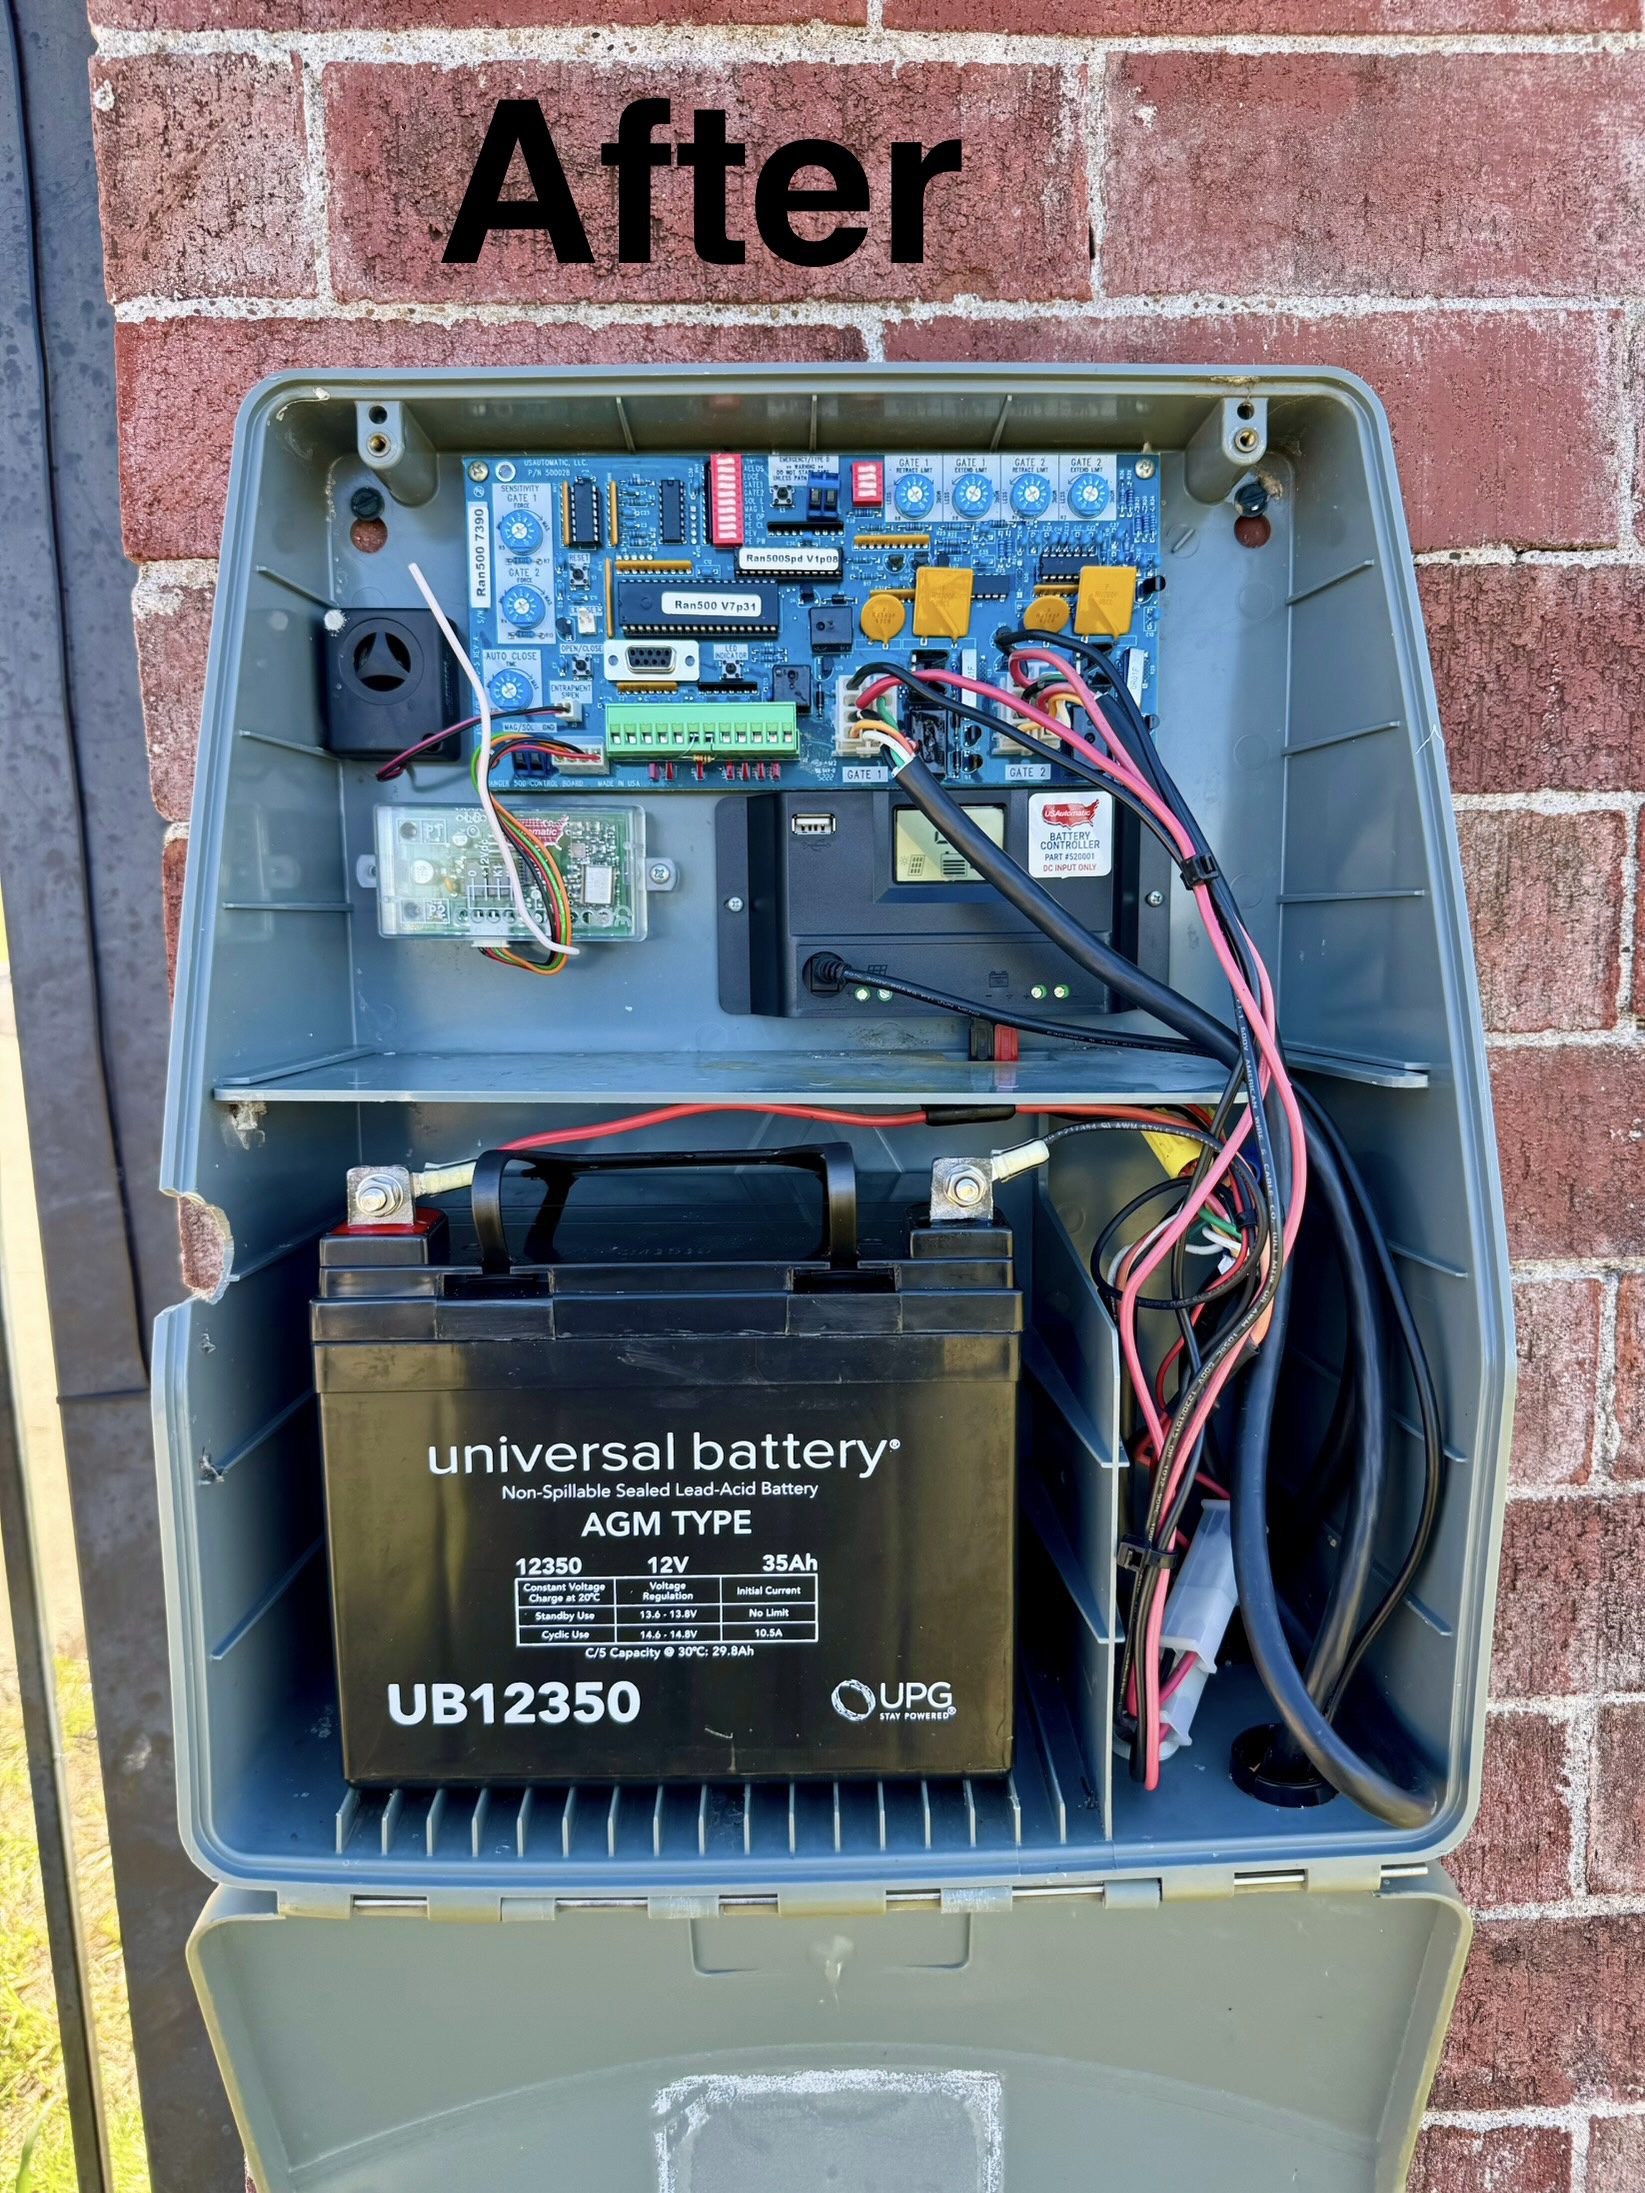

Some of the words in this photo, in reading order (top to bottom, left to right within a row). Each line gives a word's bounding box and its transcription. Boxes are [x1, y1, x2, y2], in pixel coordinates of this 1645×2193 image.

[899, 458, 920, 467] GATE
[956, 458, 977, 467] GATE
[1014, 458, 1036, 467] GATE
[1071, 458, 1092, 467] GATE
[507, 493, 530, 503] GATE
[473, 508, 485, 542] 7390
[569, 554, 590, 562] RESET
[746, 554, 803, 565] Ran500Spd
[806, 554, 839, 565] V1p08
[475, 546, 487, 597] Ran500
[508, 568, 530, 577] GATE
[675, 600, 718, 611] Ran500
[721, 600, 757, 613] V7p31
[561, 644, 602, 653] OPEN/CLOSE
[486, 652, 507, 661] AUTO
[511, 652, 537, 661] CLOSE
[551, 684, 593, 692] ENTRAPMENT
[847, 769, 872, 780] GATE
[1009, 768, 1034, 778] GATE
[1040, 768, 1046, 777] 2
[1049, 831, 1091, 841] BATTERY
[1040, 840, 1100, 851] CONTROLLER
[481, 839, 489, 878] +12Vdc
[1044, 853, 1063, 861] PART
[1043, 864, 1053, 872] DC
[1245, 1059, 1259, 1109] AMERICAN
[1263, 1163, 1274, 1196] CABLE
[1241, 1307, 1259, 1328] AWM
[428, 1432, 675, 1475] universal
[502, 1482, 612, 1502] Non-Spillable
[616, 1482, 670, 1498] Sealed
[676, 1480, 757, 1497] Lead-Acid
[760, 1480, 819, 1499] Battery
[581, 1510, 661, 1537] AGM
[671, 1509, 752, 1535] TYPE
[515, 1556, 583, 1576] 12350
[647, 1556, 690, 1575] 12V
[762, 1553, 818, 1572] 35Ah
[523, 1582, 566, 1592] Constant
[568, 1582, 606, 1593] Voltage
[649, 1581, 687, 1592] Voltage
[736, 1586, 763, 1595] Initial
[765, 1585, 801, 1595] Current
[529, 1594, 563, 1604] Charge
[565, 1594, 576, 1602] at
[642, 1591, 694, 1602] Regulation
[535, 1611, 575, 1622] Standby
[577, 1611, 595, 1620] Use
[640, 1610, 661, 1619] 13.6
[669, 1609, 698, 1618] 13.8V
[749, 1608, 764, 1617] No
[766, 1608, 789, 1617] Limit
[541, 1630, 569, 1641] Cyclic
[571, 1630, 590, 1639] Use
[640, 1630, 661, 1639] 14.6
[670, 1630, 698, 1639] 14.8V
[755, 1628, 783, 1637] 10.5A
[585, 1648, 606, 1658] C/5
[609, 1647, 661, 1660] Capacity
[664, 1646, 675, 1657] @
[712, 1645, 755, 1656] 29.8Ah
[880, 1682, 953, 1709] UPG
[388, 1681, 641, 1726] UB12350
